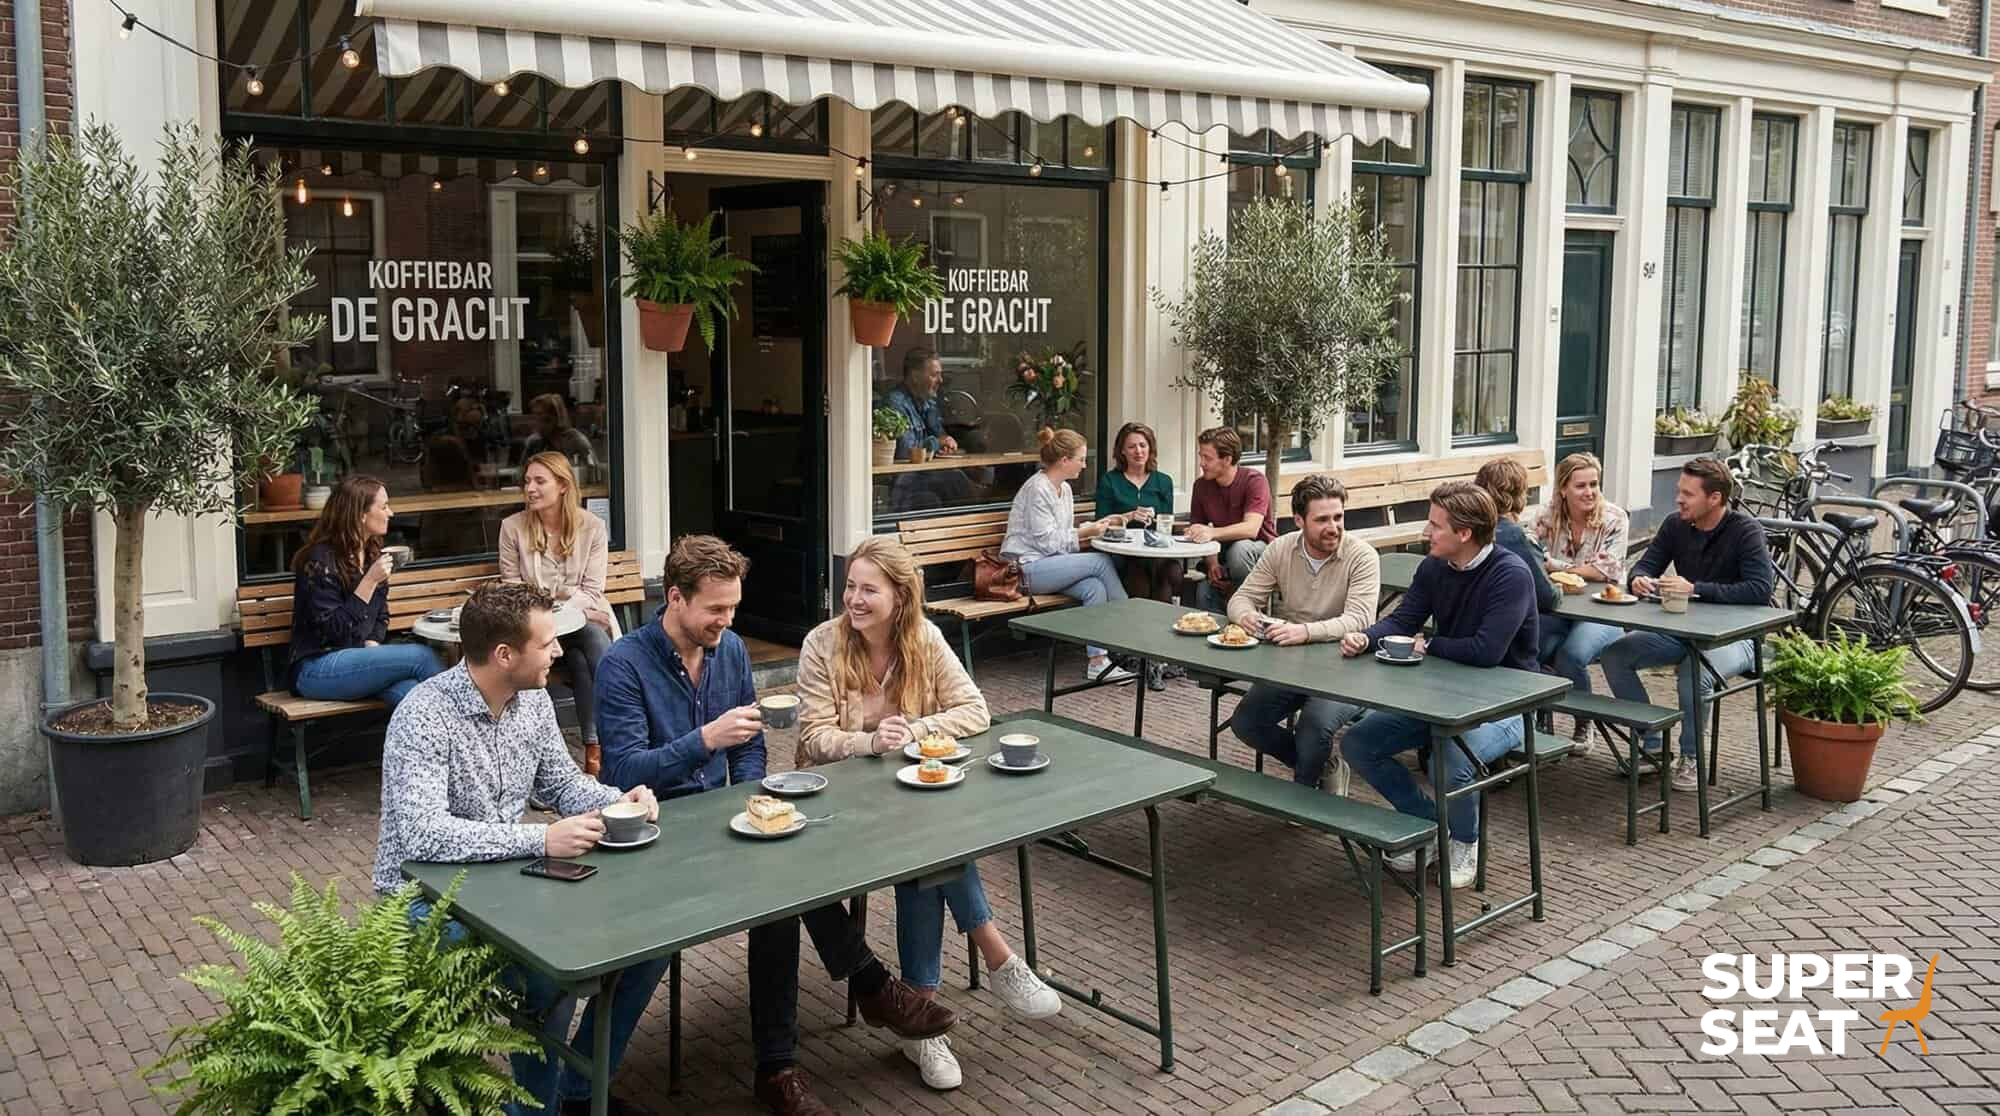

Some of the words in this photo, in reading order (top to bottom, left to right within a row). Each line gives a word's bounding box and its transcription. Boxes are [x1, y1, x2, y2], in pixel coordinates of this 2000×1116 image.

[368, 260, 492, 289] KOFFIEBAR
[948, 268, 1029, 293] KOFFIEBAR
[331, 297, 379, 342] DE
[391, 297, 530, 341] GRACHT
[924, 297, 955, 334] DE
[961, 297, 1053, 334] GRACHT
